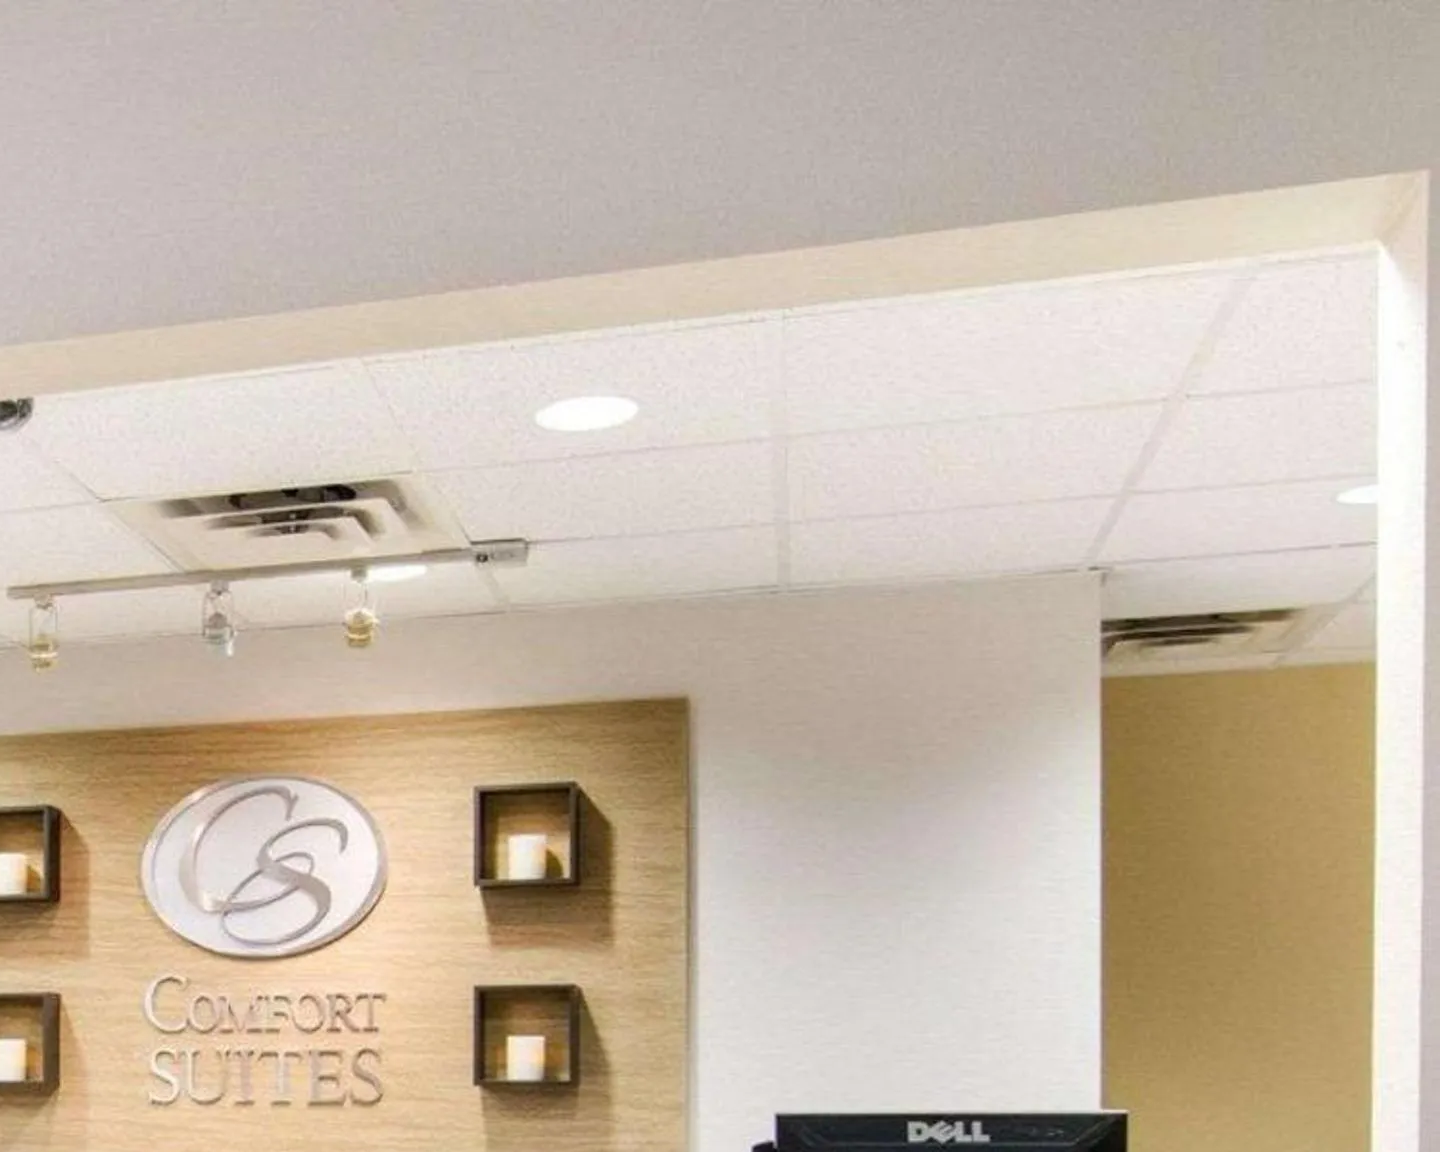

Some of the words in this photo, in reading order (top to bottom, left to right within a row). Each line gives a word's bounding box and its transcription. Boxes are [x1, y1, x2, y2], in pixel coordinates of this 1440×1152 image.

[143, 974, 387, 1034] COMFORT
[147, 1047, 385, 1107] SUITES
[907, 1120, 991, 1144] DELL
